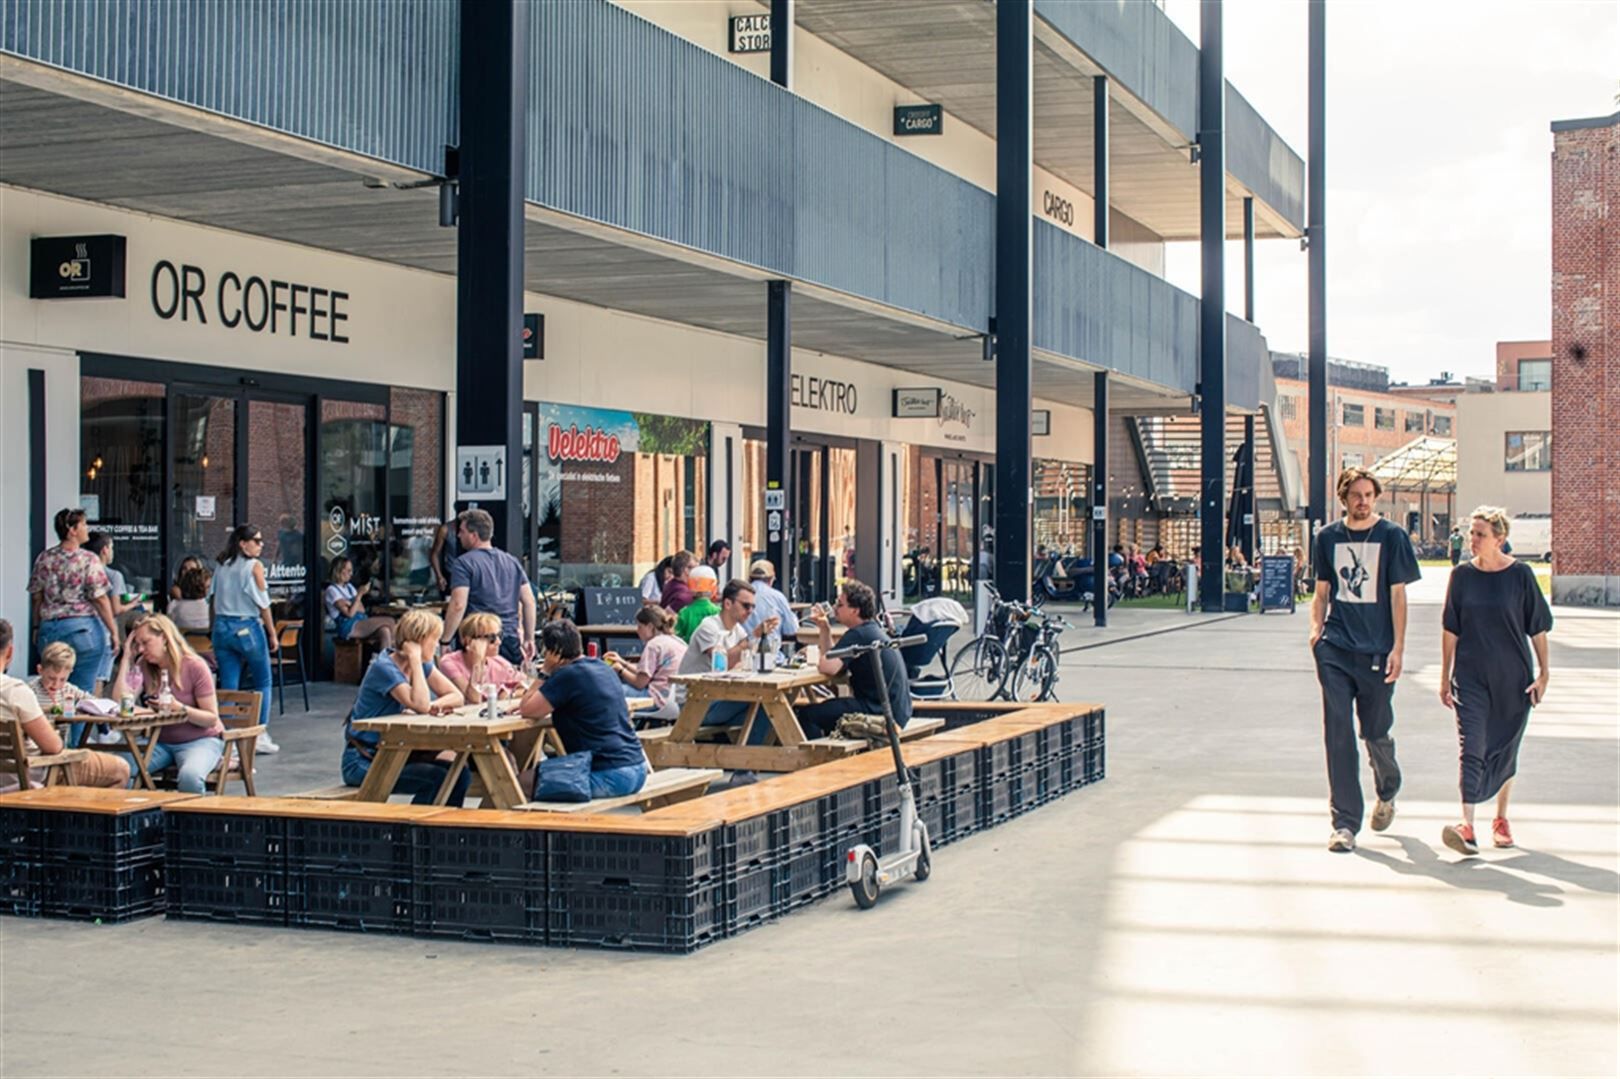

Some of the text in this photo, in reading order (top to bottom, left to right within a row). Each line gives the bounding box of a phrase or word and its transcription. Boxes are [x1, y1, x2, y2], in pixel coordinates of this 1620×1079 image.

[736, 16, 771, 32] CALC
[738, 34, 770, 50] STOR
[1044, 190, 1073, 226] CARGO
[59, 262, 81, 277] OR
[151, 260, 349, 343] OR COFFEE
[791, 373, 857, 414] ELEKTRO
[548, 424, 620, 463] Velektro
[270, 564, 307, 578] Attento
